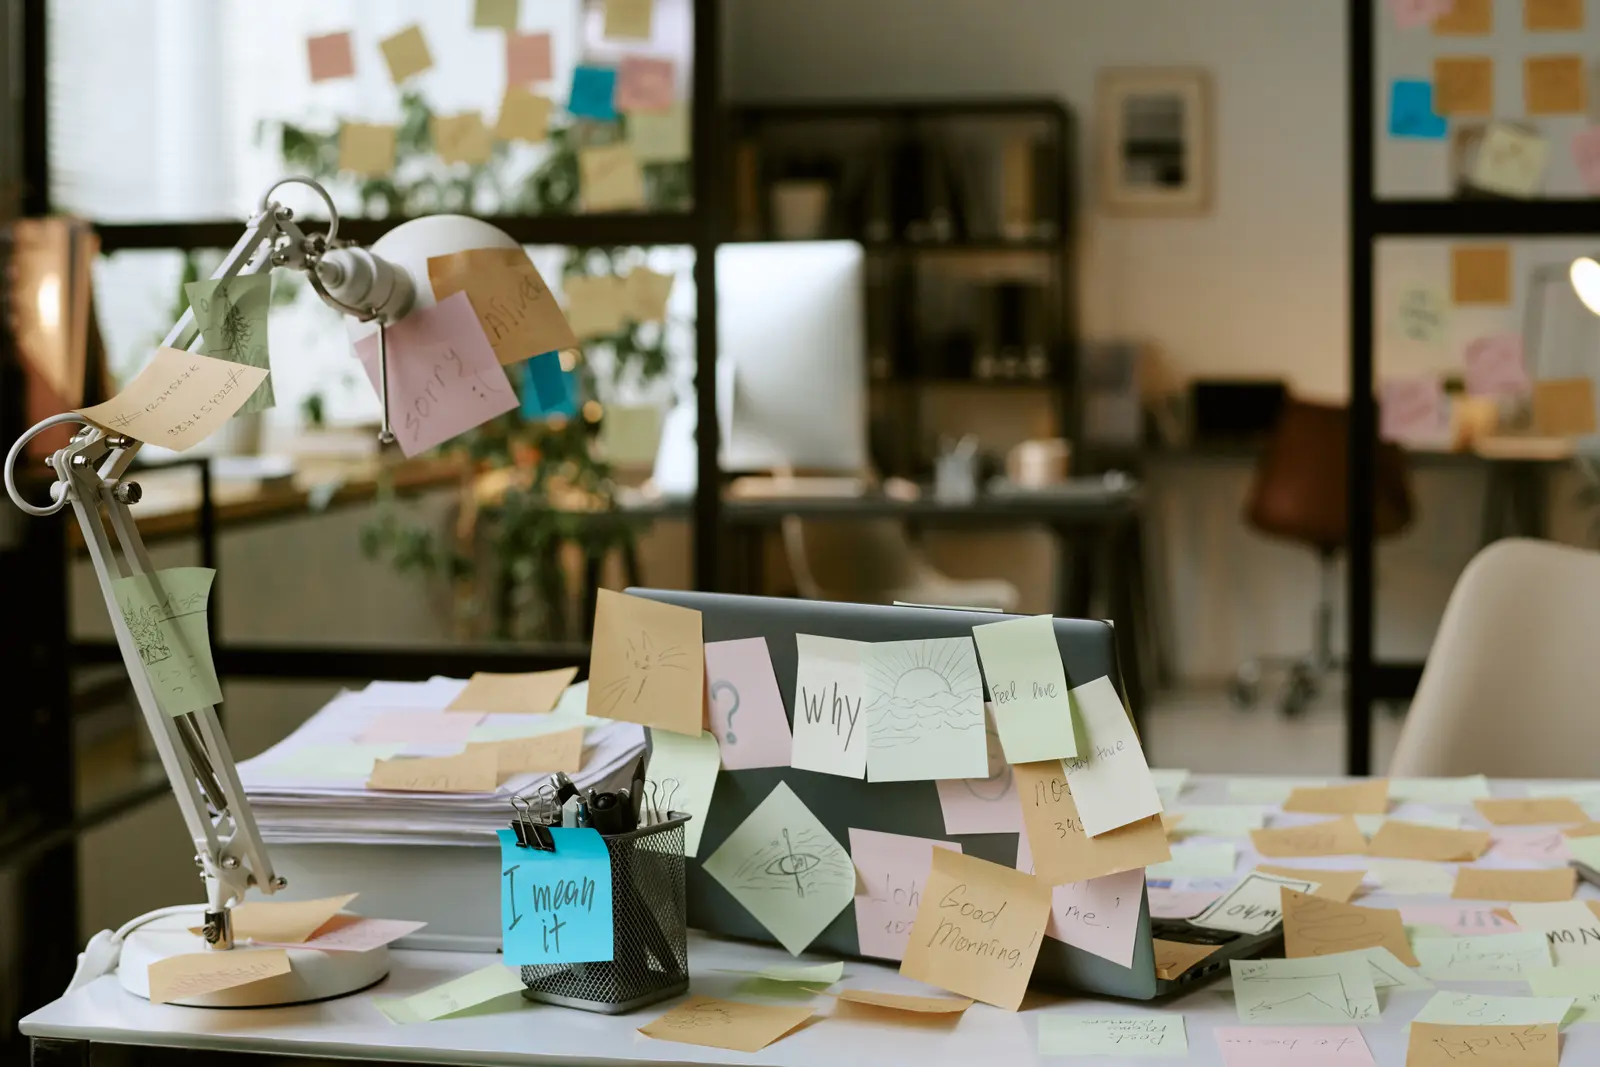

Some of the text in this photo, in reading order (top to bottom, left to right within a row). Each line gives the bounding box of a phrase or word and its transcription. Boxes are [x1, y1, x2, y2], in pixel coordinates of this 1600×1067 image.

[992, 680, 1059, 706] Feel love
[802, 681, 862, 752] Why
[1064, 740, 1126, 776] Stay true
[503, 864, 595, 931] I mean
[939, 884, 1008, 929] Good
[541, 913, 567, 954] it
